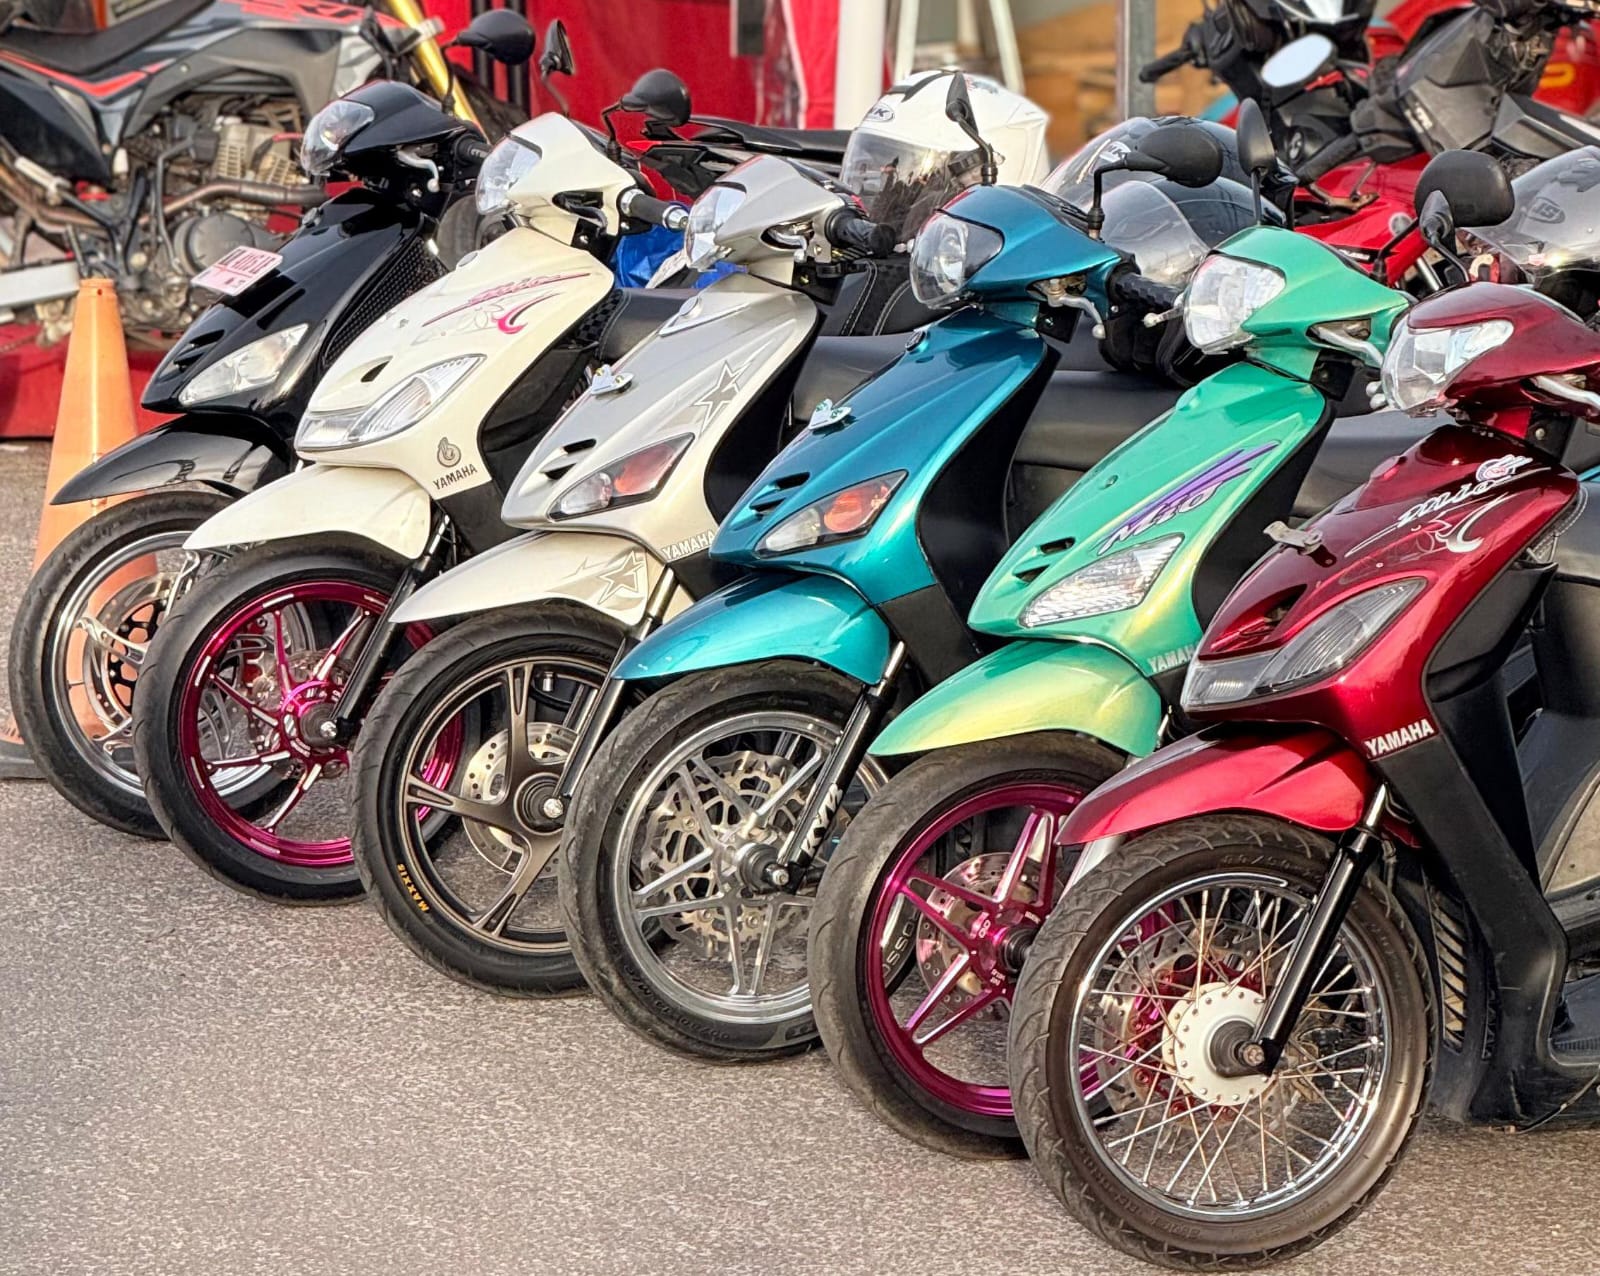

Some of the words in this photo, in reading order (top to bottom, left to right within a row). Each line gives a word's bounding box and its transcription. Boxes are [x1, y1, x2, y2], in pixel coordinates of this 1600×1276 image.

[432, 463, 478, 490] YAMAHA
[661, 529, 716, 560] YAMAHA
[1146, 644, 1198, 673] YAMAH
[1363, 718, 1435, 757] YAMAHA
[397, 863, 430, 912] MAXXIS
